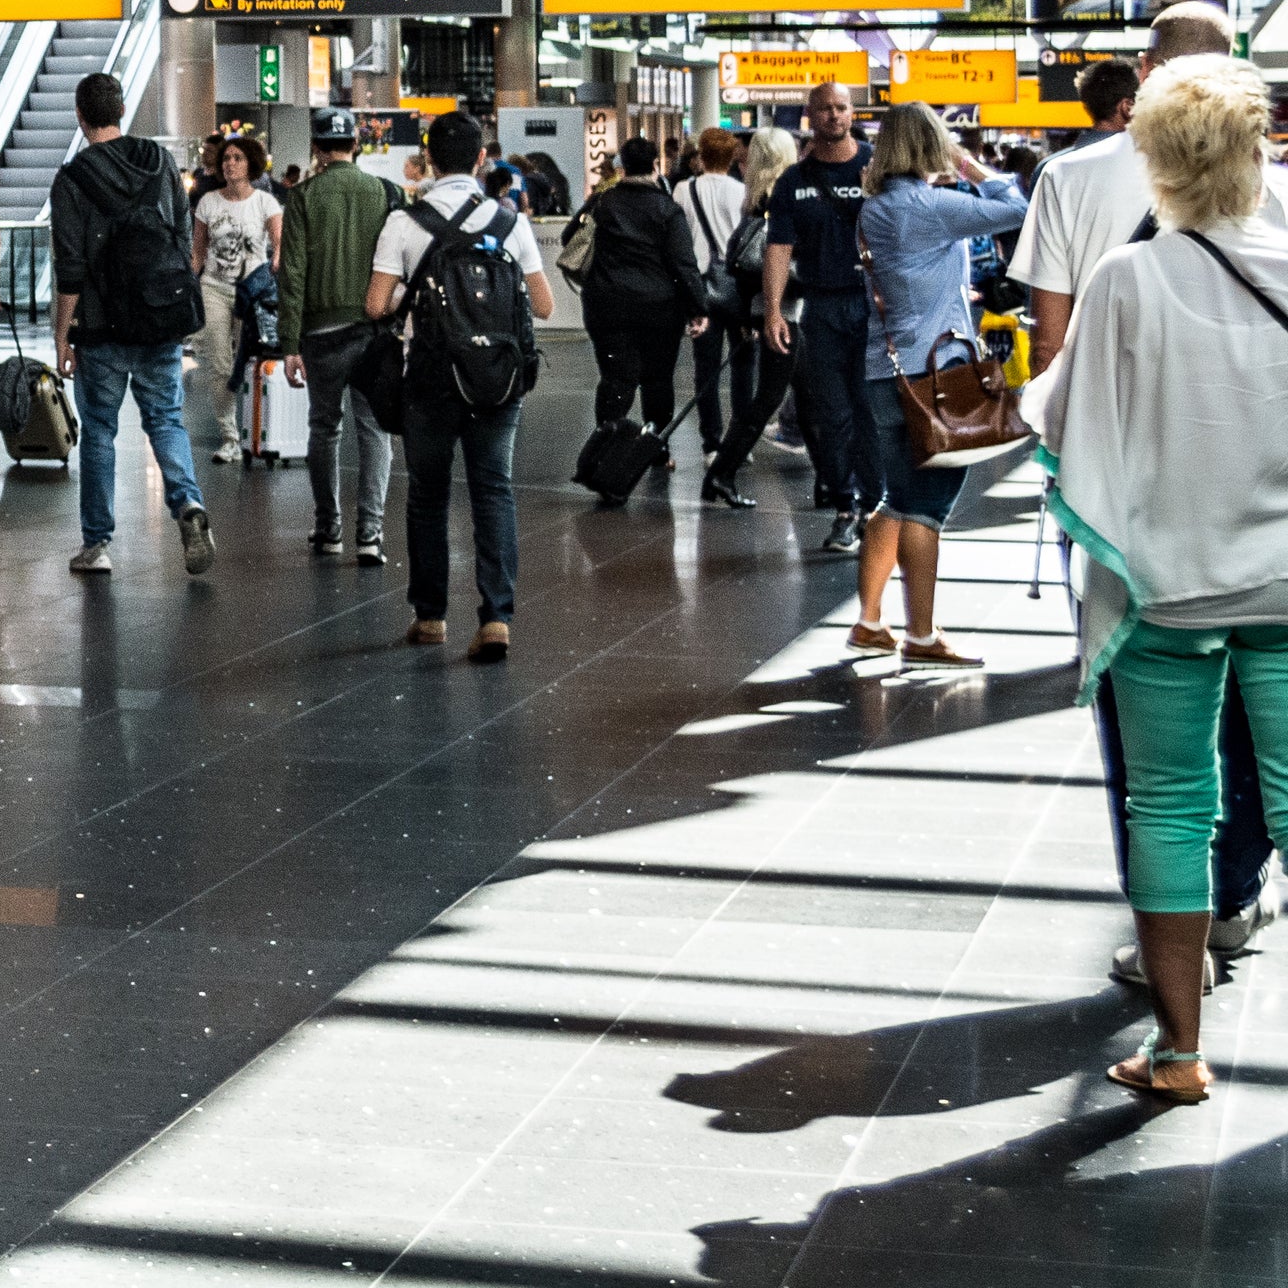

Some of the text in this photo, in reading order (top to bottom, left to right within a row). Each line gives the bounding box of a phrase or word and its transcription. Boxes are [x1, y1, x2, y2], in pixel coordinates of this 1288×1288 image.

[237, 0, 252, 13] By
[753, 54, 840, 65] Baggage hall
[754, 73, 805, 82] Arrivals
[589, 112, 606, 175] ASSES
